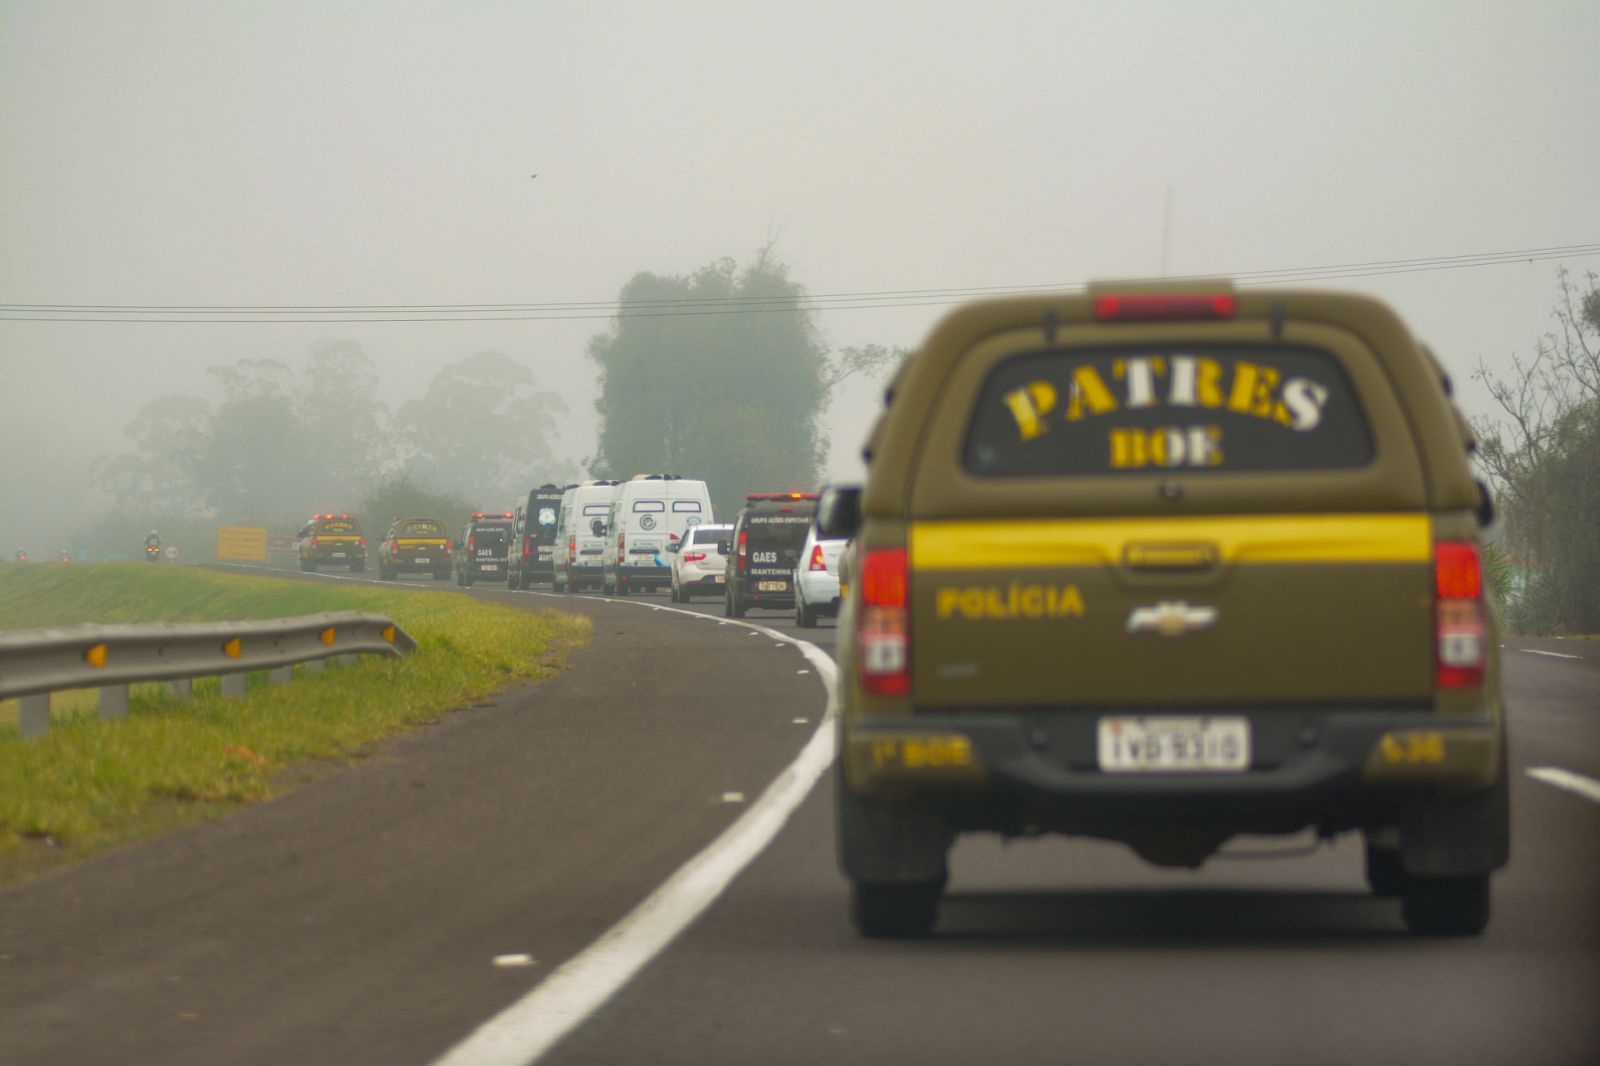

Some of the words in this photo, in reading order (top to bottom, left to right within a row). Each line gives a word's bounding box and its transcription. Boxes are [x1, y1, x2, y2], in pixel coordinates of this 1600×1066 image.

[1004, 355, 1329, 441] PATRES
[1109, 426, 1223, 468] BOE
[477, 548, 493, 557] GAES
[752, 551, 777, 563] GAES
[751, 568, 791, 576] MANTENHA
[936, 580, 1084, 619] POLÍCIA
